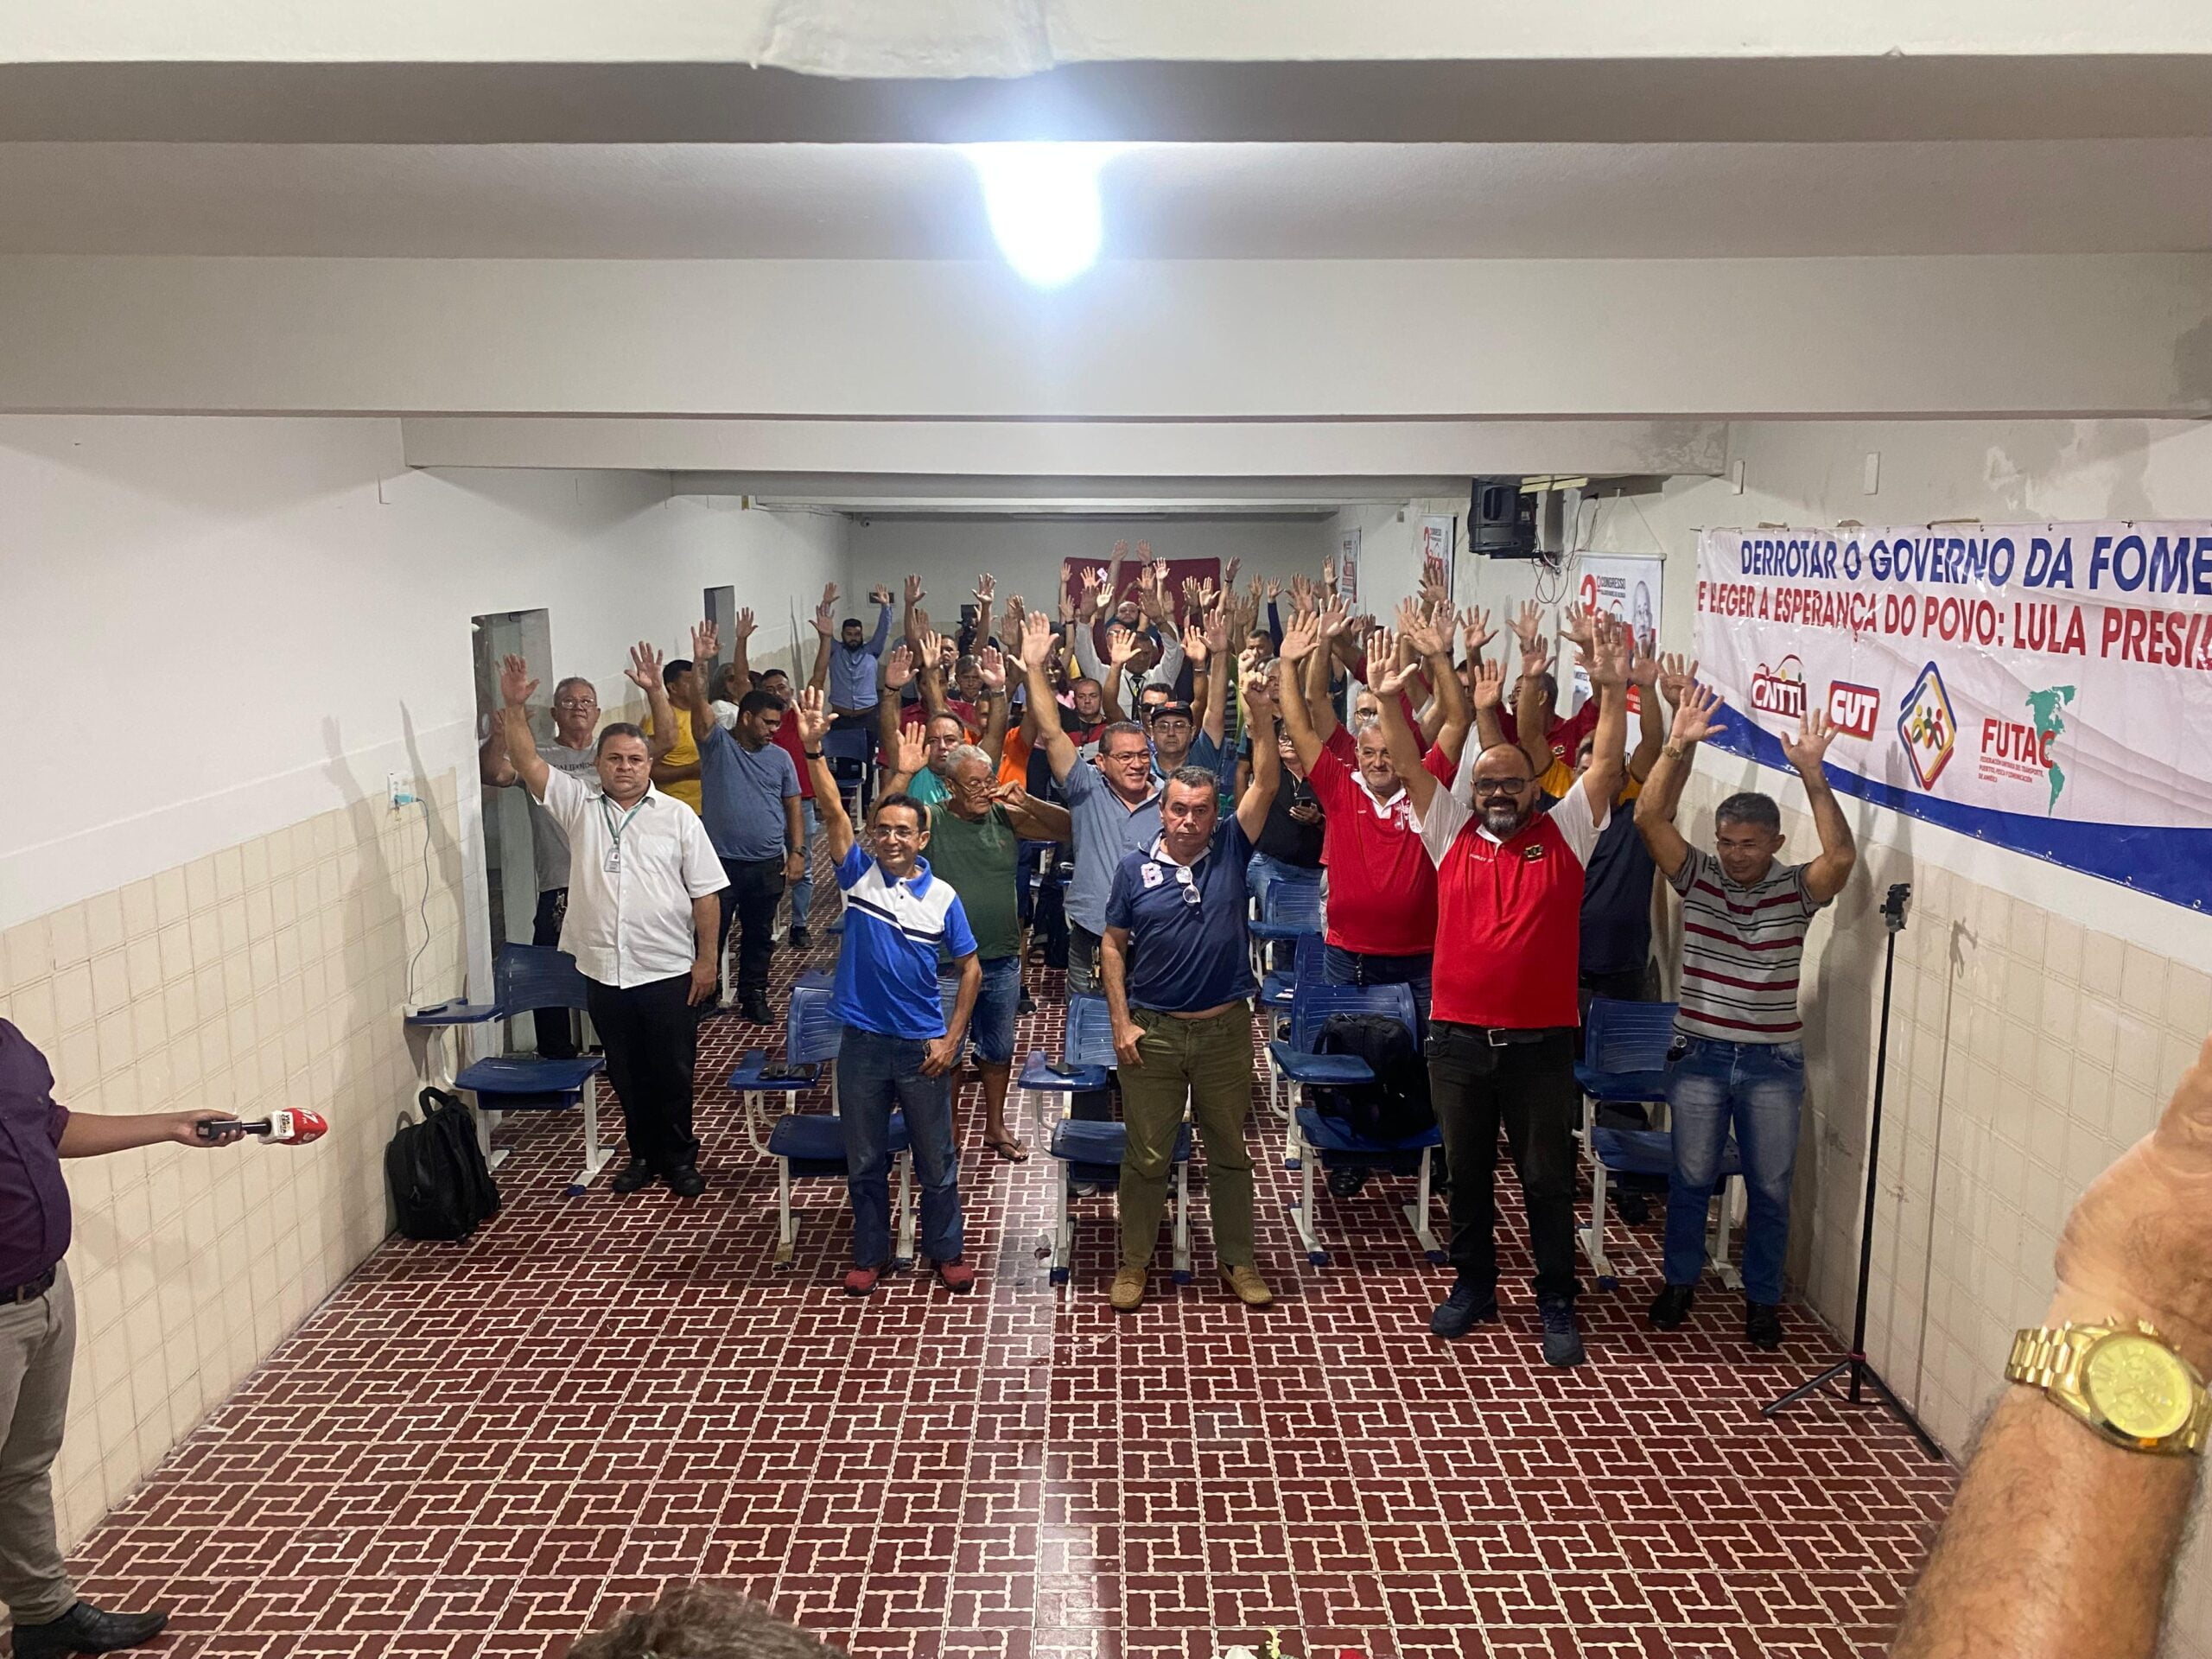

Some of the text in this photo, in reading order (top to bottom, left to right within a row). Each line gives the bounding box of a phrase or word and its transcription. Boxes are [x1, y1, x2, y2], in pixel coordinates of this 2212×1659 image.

[1741, 535, 2212, 595] DERROTAR O GOVERNO DA FOME
[1698, 581, 1707, 611] E
[1758, 587, 1769, 620] A
[1774, 588, 1877, 642] ESPERANÇA
[1885, 594, 1916, 636] DO
[1923, 595, 2005, 646] POVO:
[2013, 602, 2086, 656] LULA
[1830, 689, 1878, 733] CUT
[1981, 718, 2056, 769] FUTAC
